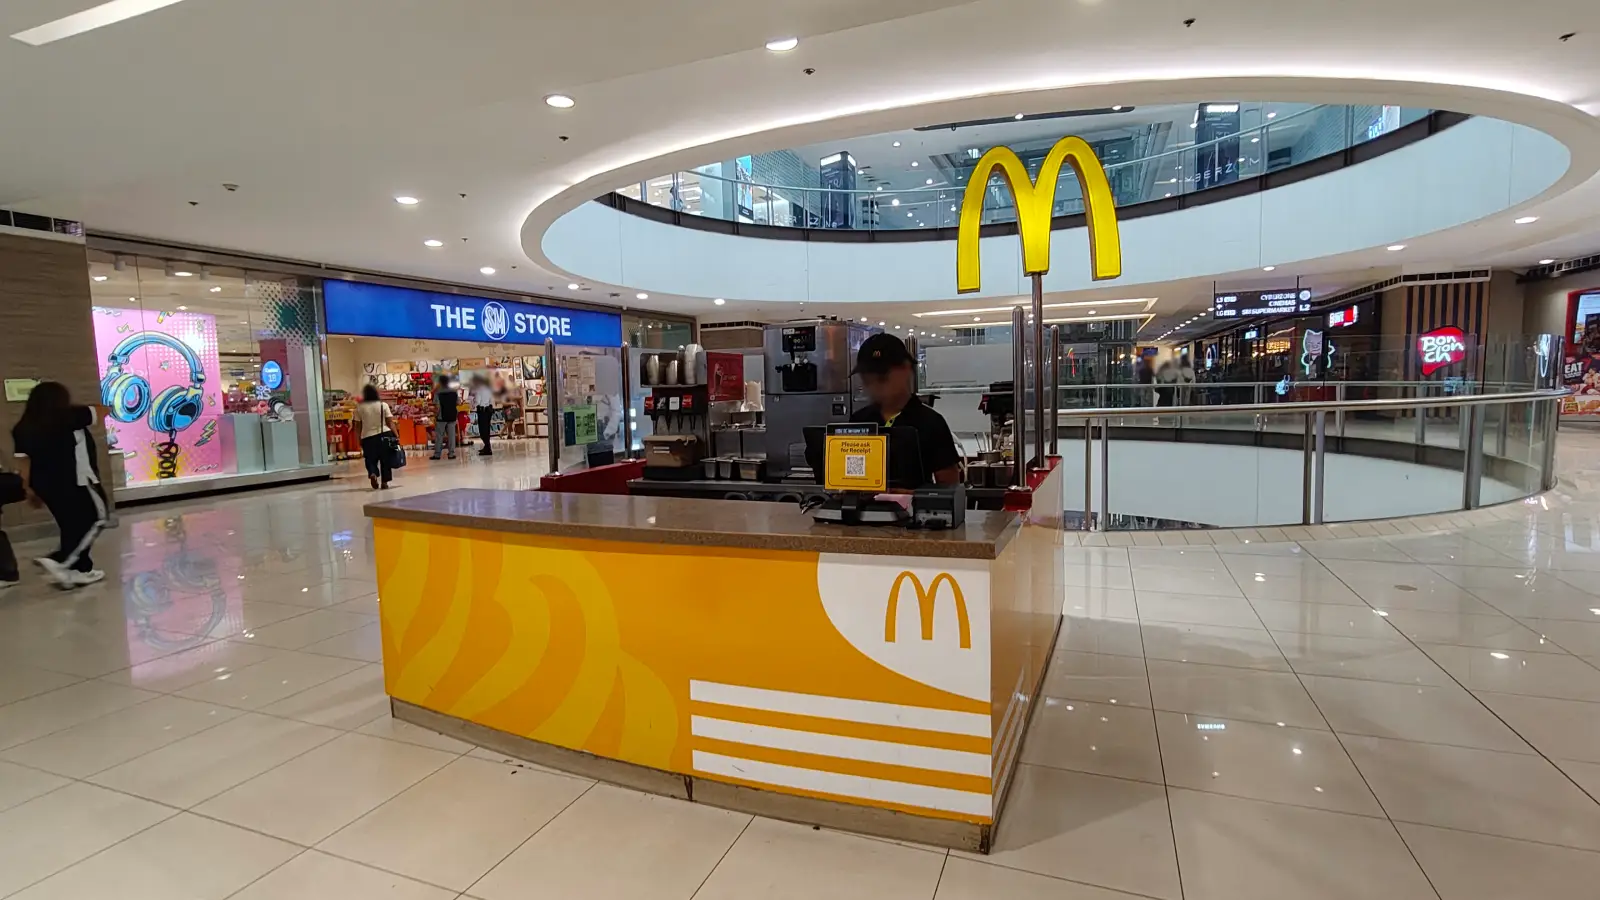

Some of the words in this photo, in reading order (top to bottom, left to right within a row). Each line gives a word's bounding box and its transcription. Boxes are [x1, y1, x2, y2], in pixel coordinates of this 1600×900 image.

[1252, 306, 1296, 315] SUPERMARKET
[1299, 303, 1311, 312] L2
[430, 304, 476, 330] THE
[484, 305, 506, 335] SM
[514, 312, 572, 337] STORE
[1565, 362, 1584, 373] EAT
